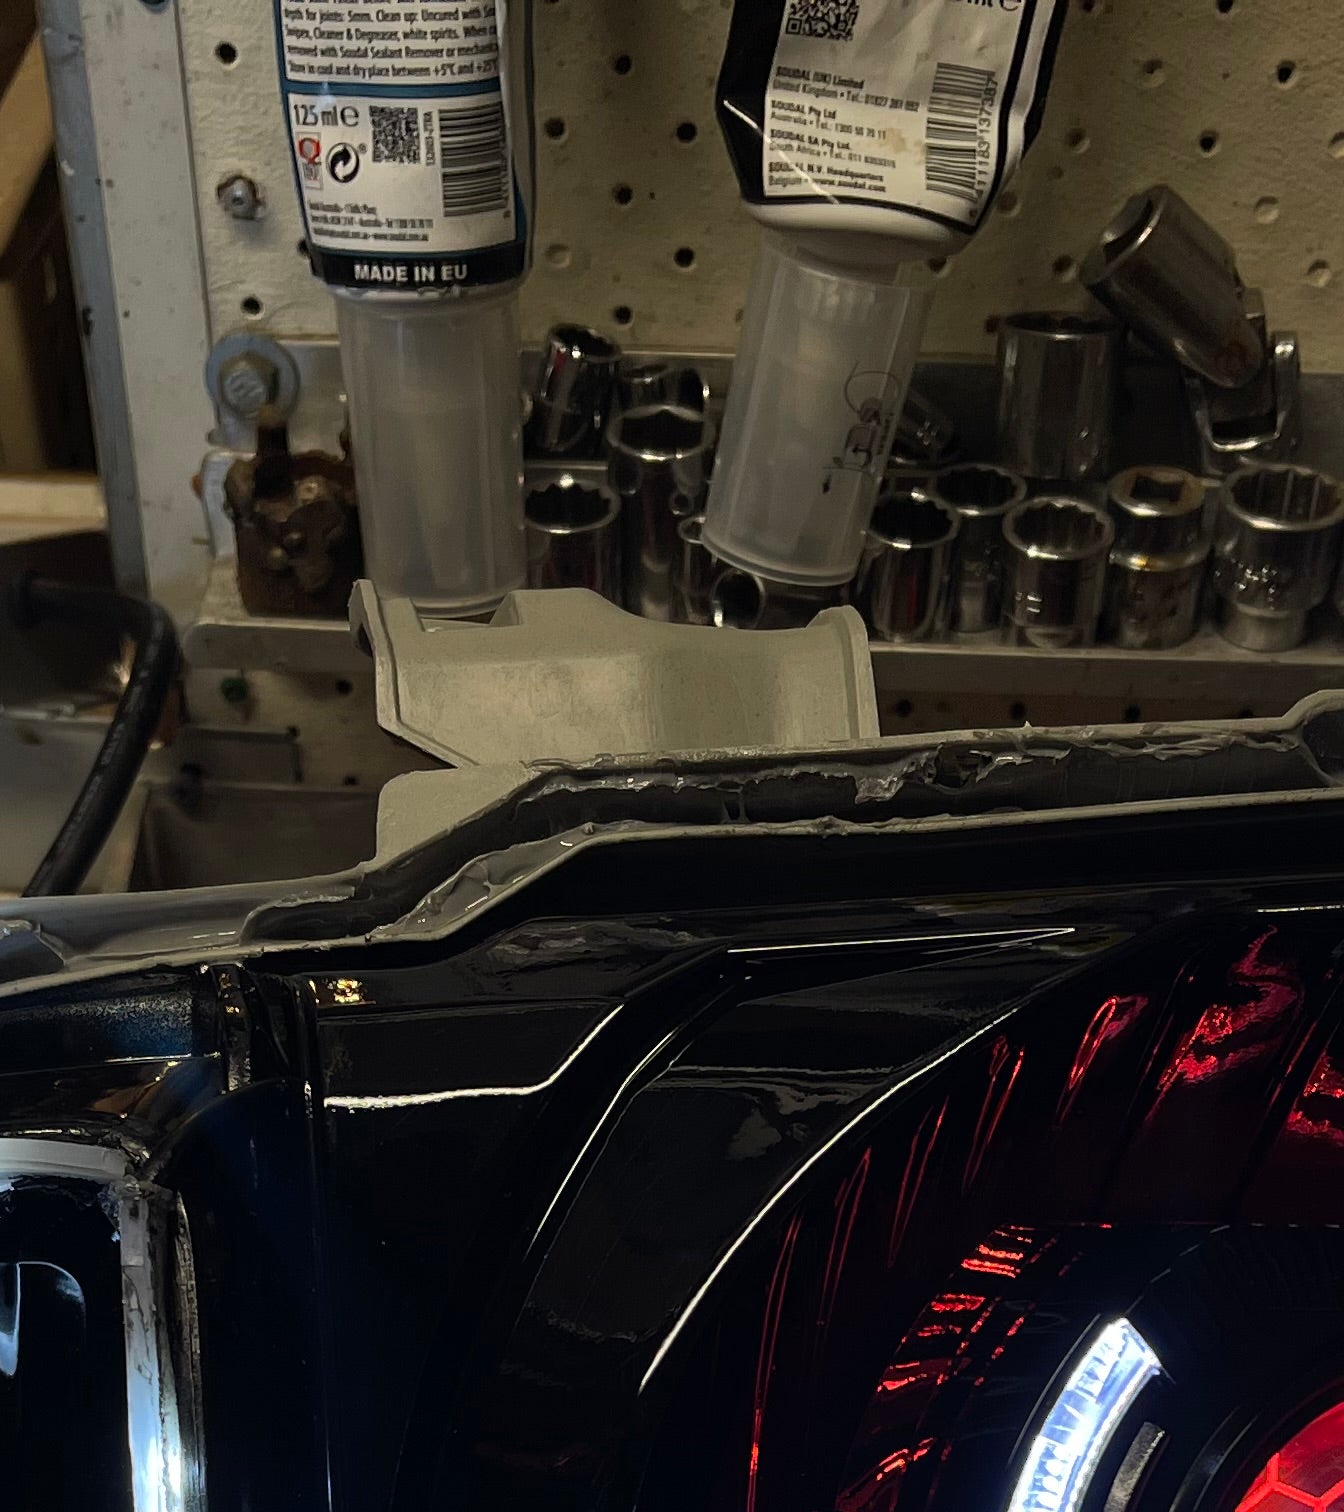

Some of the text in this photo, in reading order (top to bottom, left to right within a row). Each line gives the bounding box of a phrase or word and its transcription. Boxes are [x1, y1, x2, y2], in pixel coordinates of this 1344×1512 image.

[376, 9, 401, 22] Clean
[421, 8, 459, 22] Uncured
[313, 26, 344, 40] Cleaner
[346, 28, 353, 41] &
[402, 29, 428, 40] white
[320, 46, 338, 58] with
[404, 45, 444, 59] Remover
[336, 63, 351, 76] and
[353, 64, 366, 79] dry
[368, 64, 390, 79] place
[391, 64, 431, 77] between
[457, 60, 475, 75] and
[293, 104, 319, 127] 125
[321, 106, 338, 127] ml
[353, 264, 468, 282] MADE IN EU
